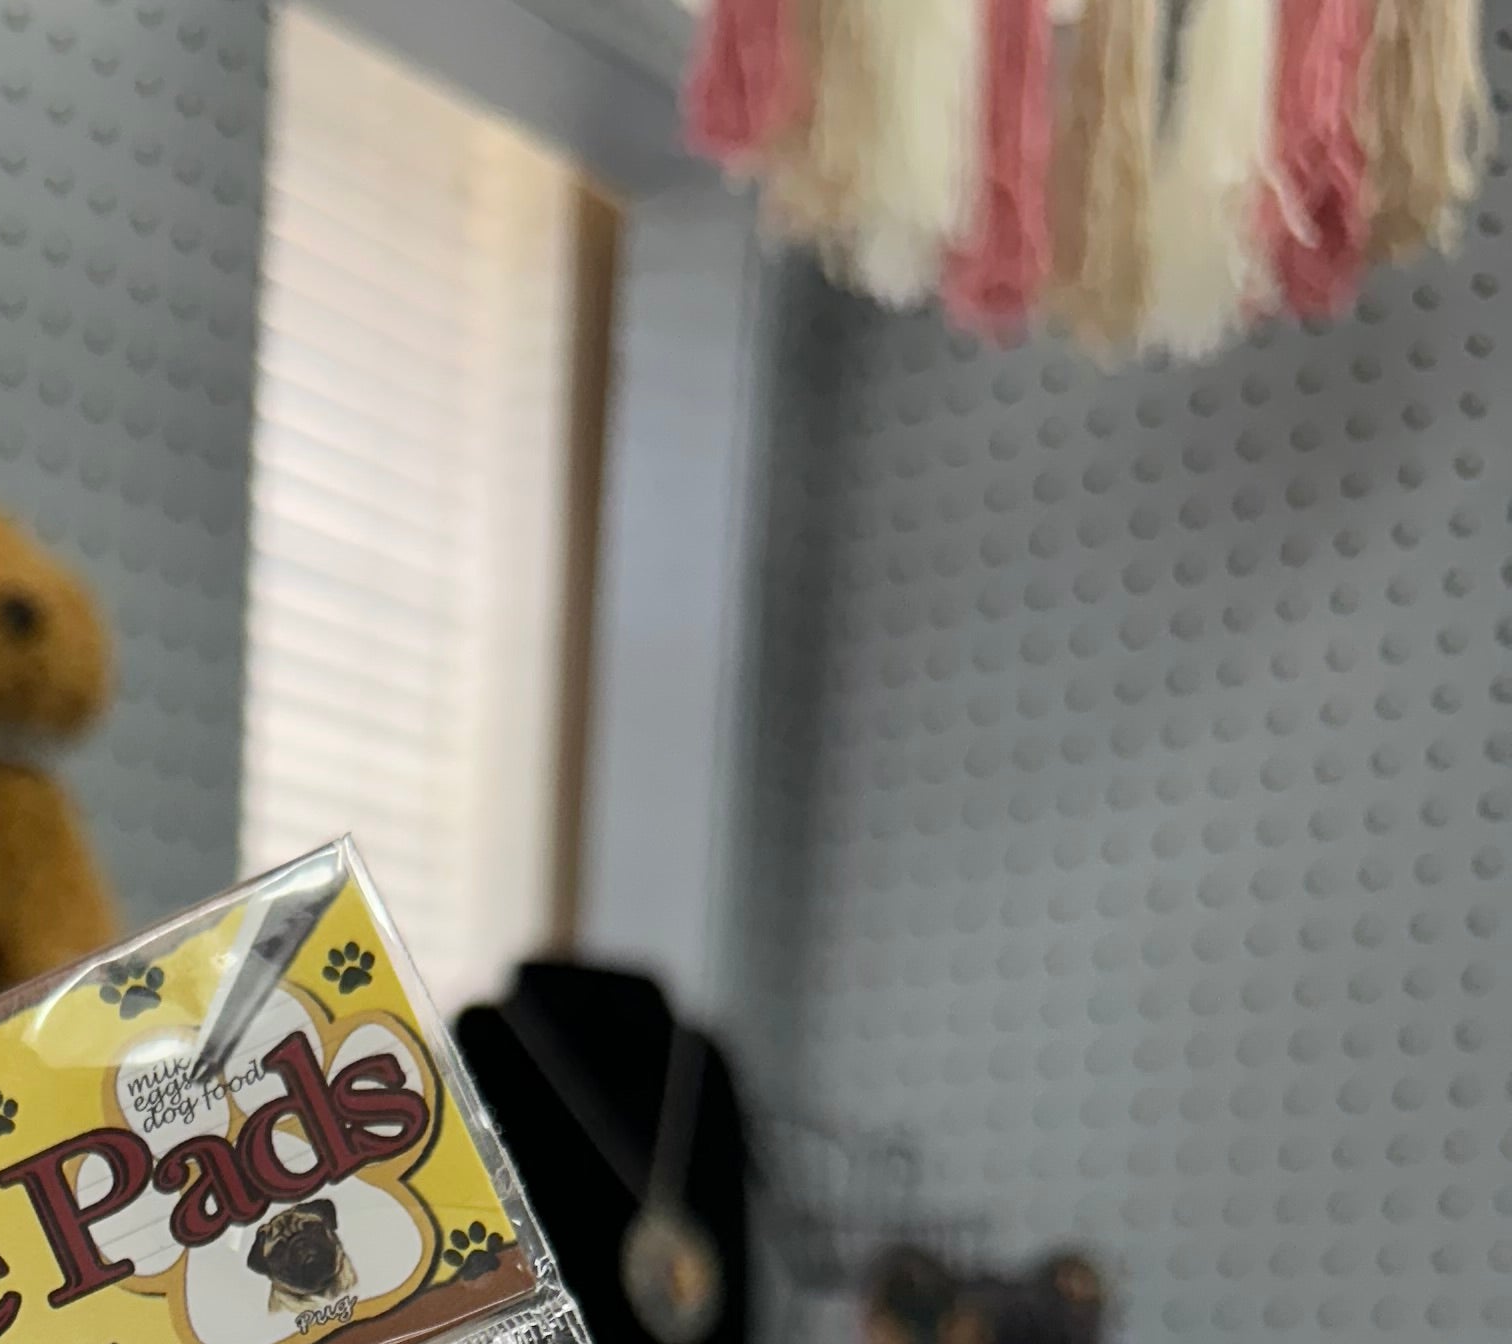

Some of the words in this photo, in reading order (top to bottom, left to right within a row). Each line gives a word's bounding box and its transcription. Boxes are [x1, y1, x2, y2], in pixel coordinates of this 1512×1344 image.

[127, 1058, 192, 1096] milk
[133, 1072, 192, 1114] eggs
[143, 1097, 199, 1133] dog
[201, 1059, 265, 1110] food
[294, 1295, 359, 1335] Pug
